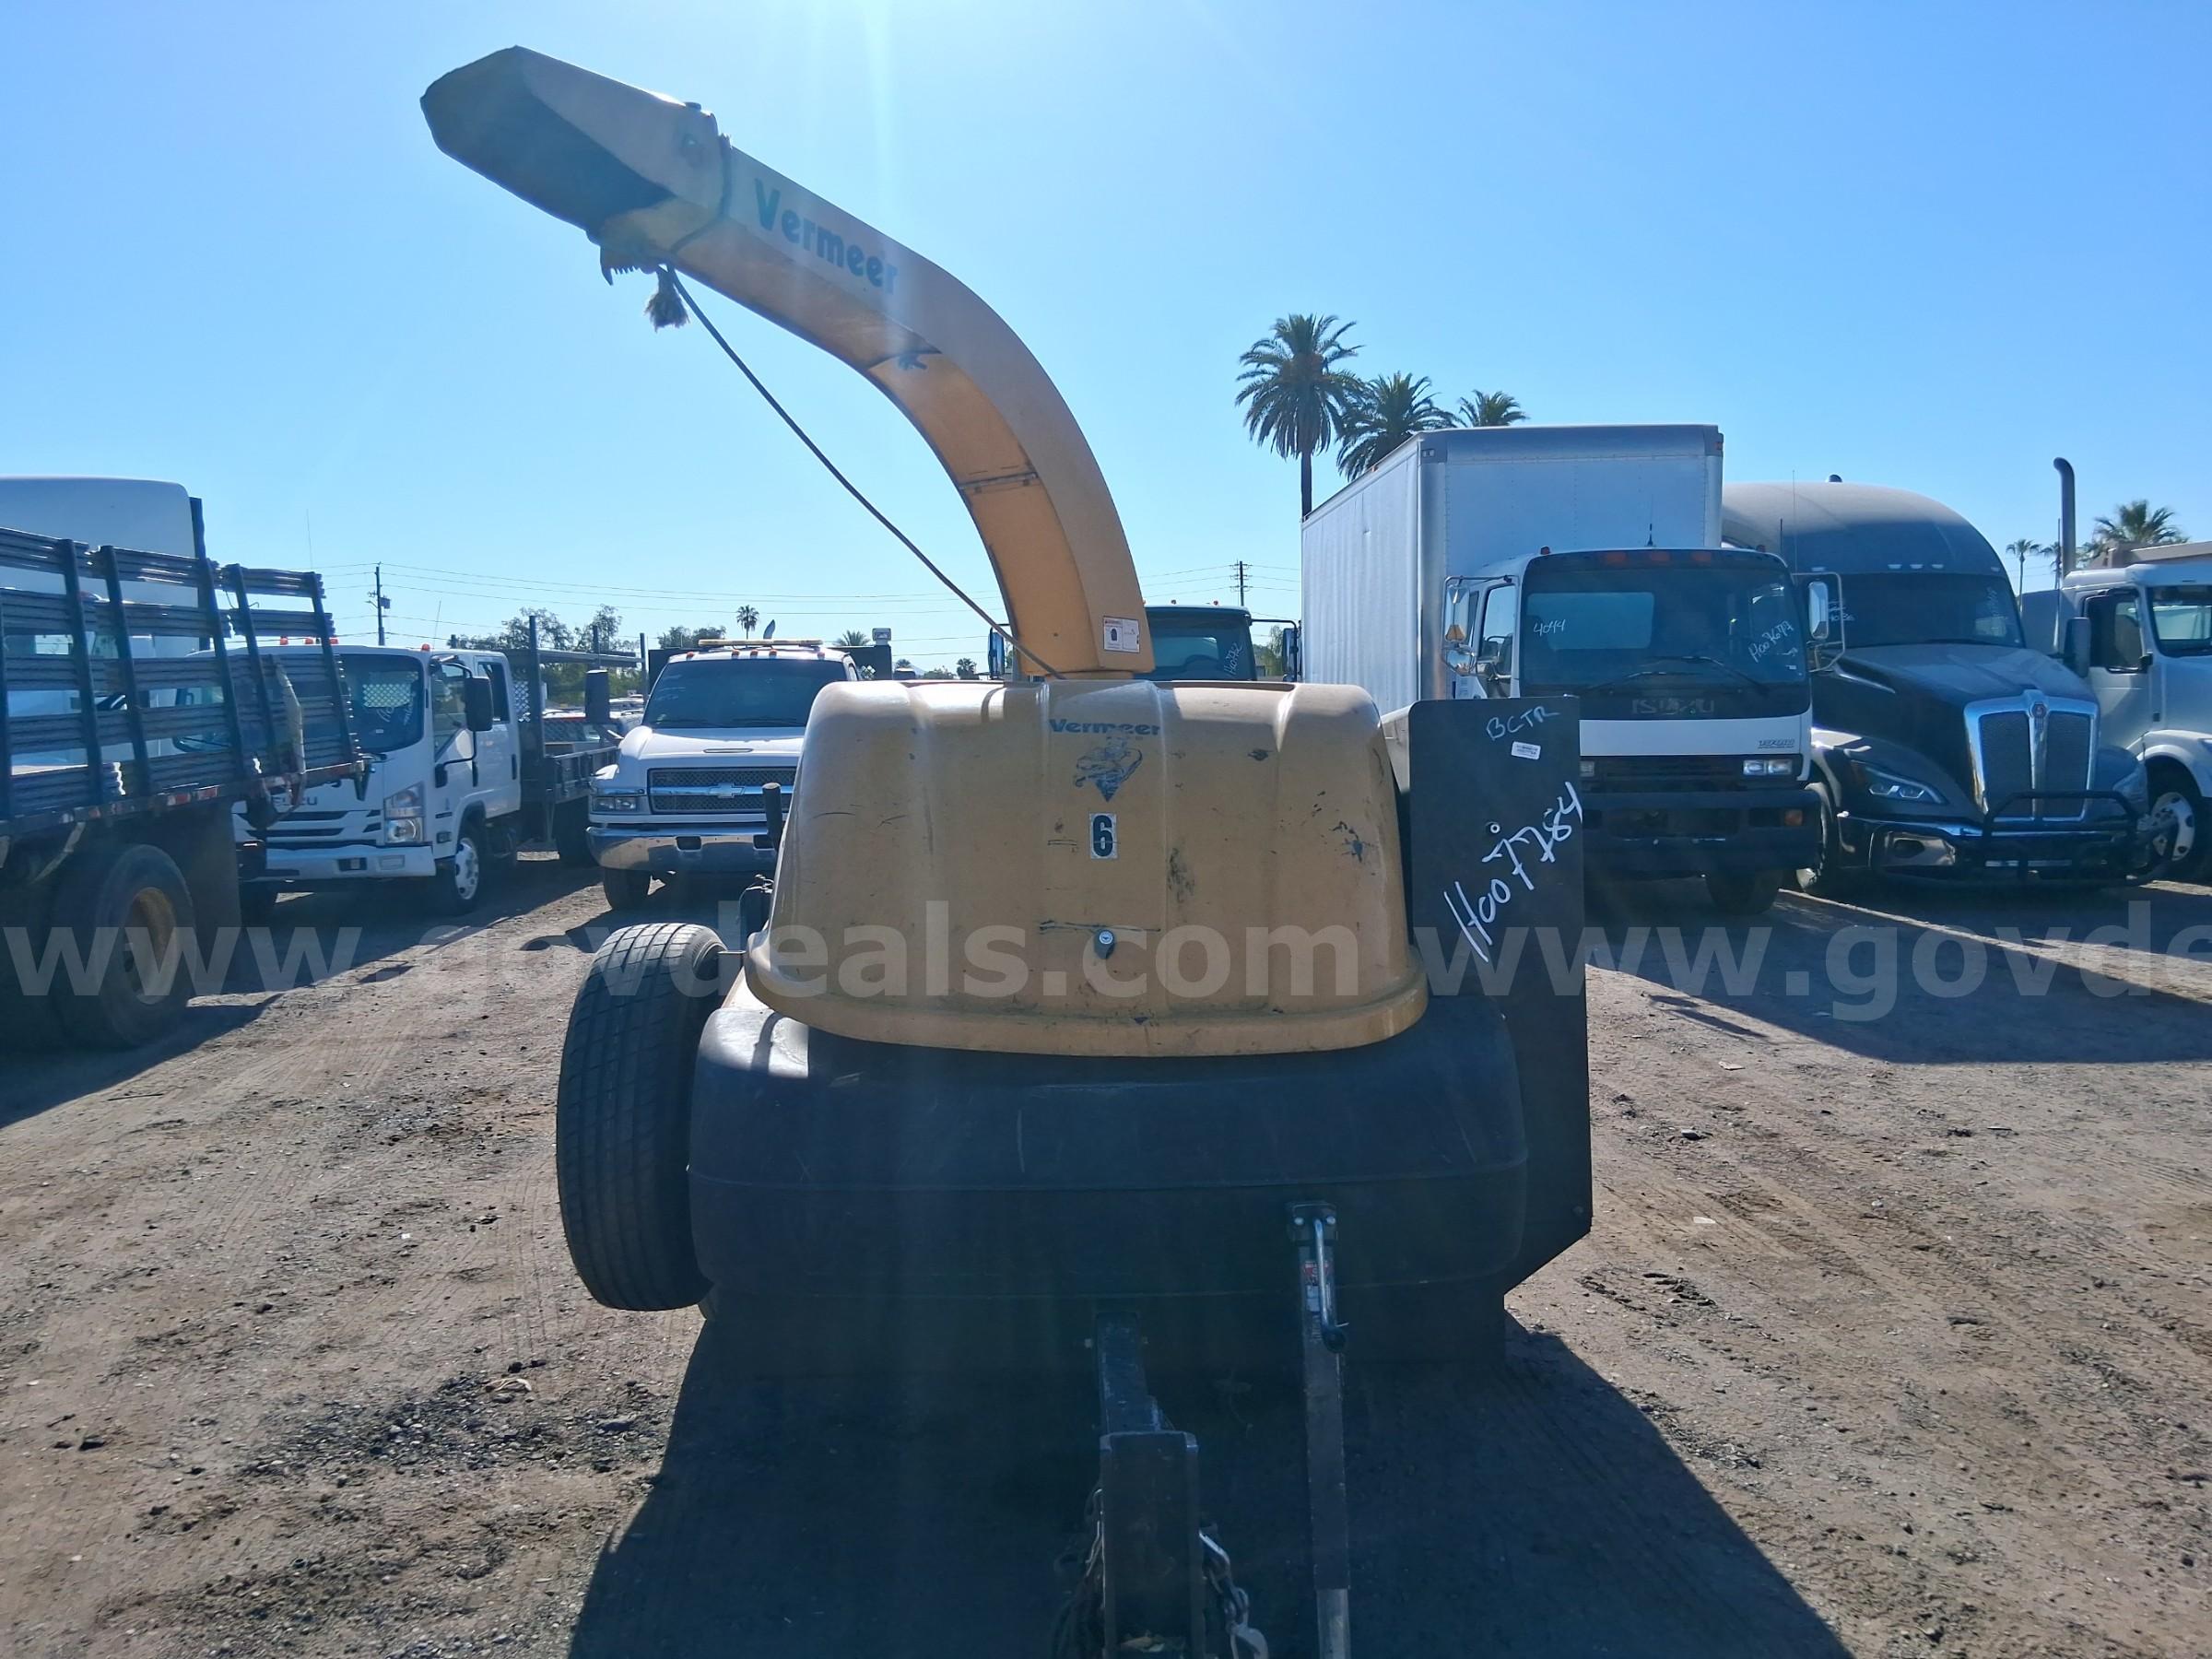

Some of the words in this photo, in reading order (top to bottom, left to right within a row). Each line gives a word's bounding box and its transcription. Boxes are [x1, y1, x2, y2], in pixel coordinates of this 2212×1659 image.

[754, 177, 899, 296] Vermeer
[1049, 718, 1161, 735] Vermeer
[1092, 814, 1113, 857] 6
[1443, 781, 1584, 963] H007784
